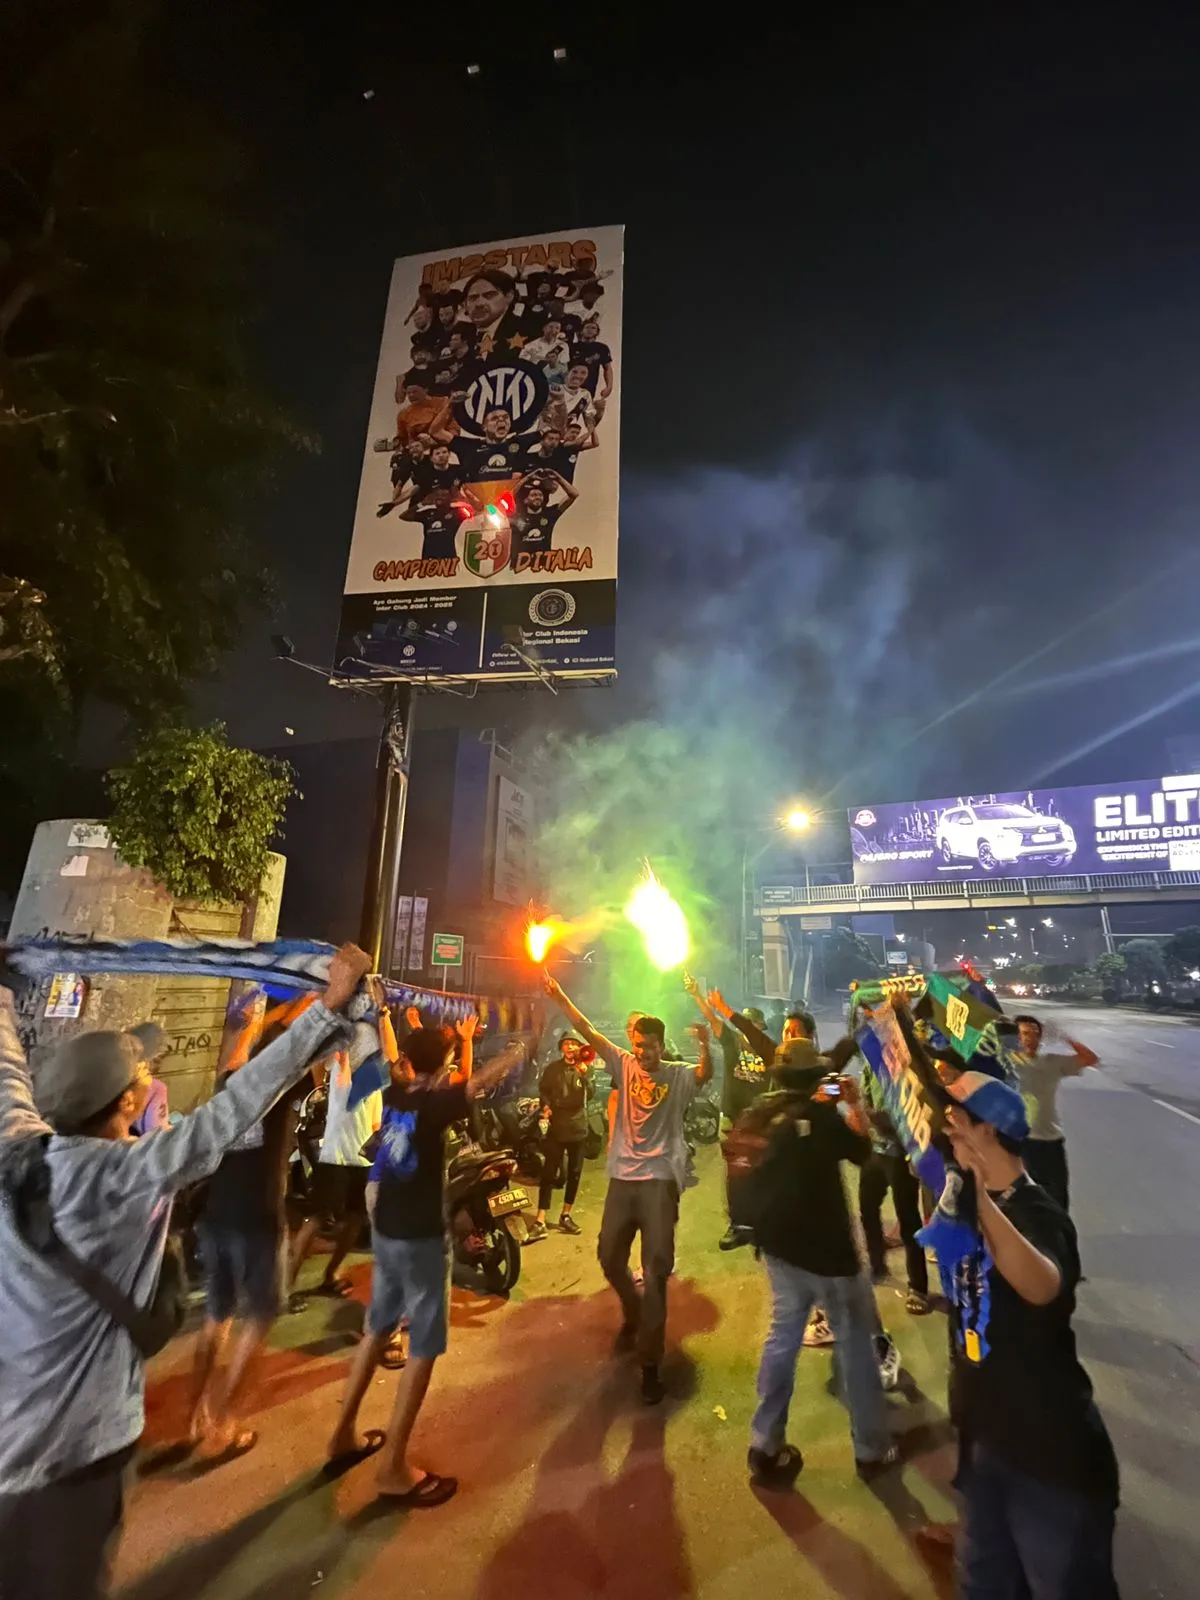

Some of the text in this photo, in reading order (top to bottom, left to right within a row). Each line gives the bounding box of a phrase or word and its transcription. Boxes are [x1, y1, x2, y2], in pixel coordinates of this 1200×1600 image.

[373, 557, 460, 581] CAMPIONI
[1094, 790, 1200, 827] ELIT
[1096, 828, 1160, 842] LIMITED
